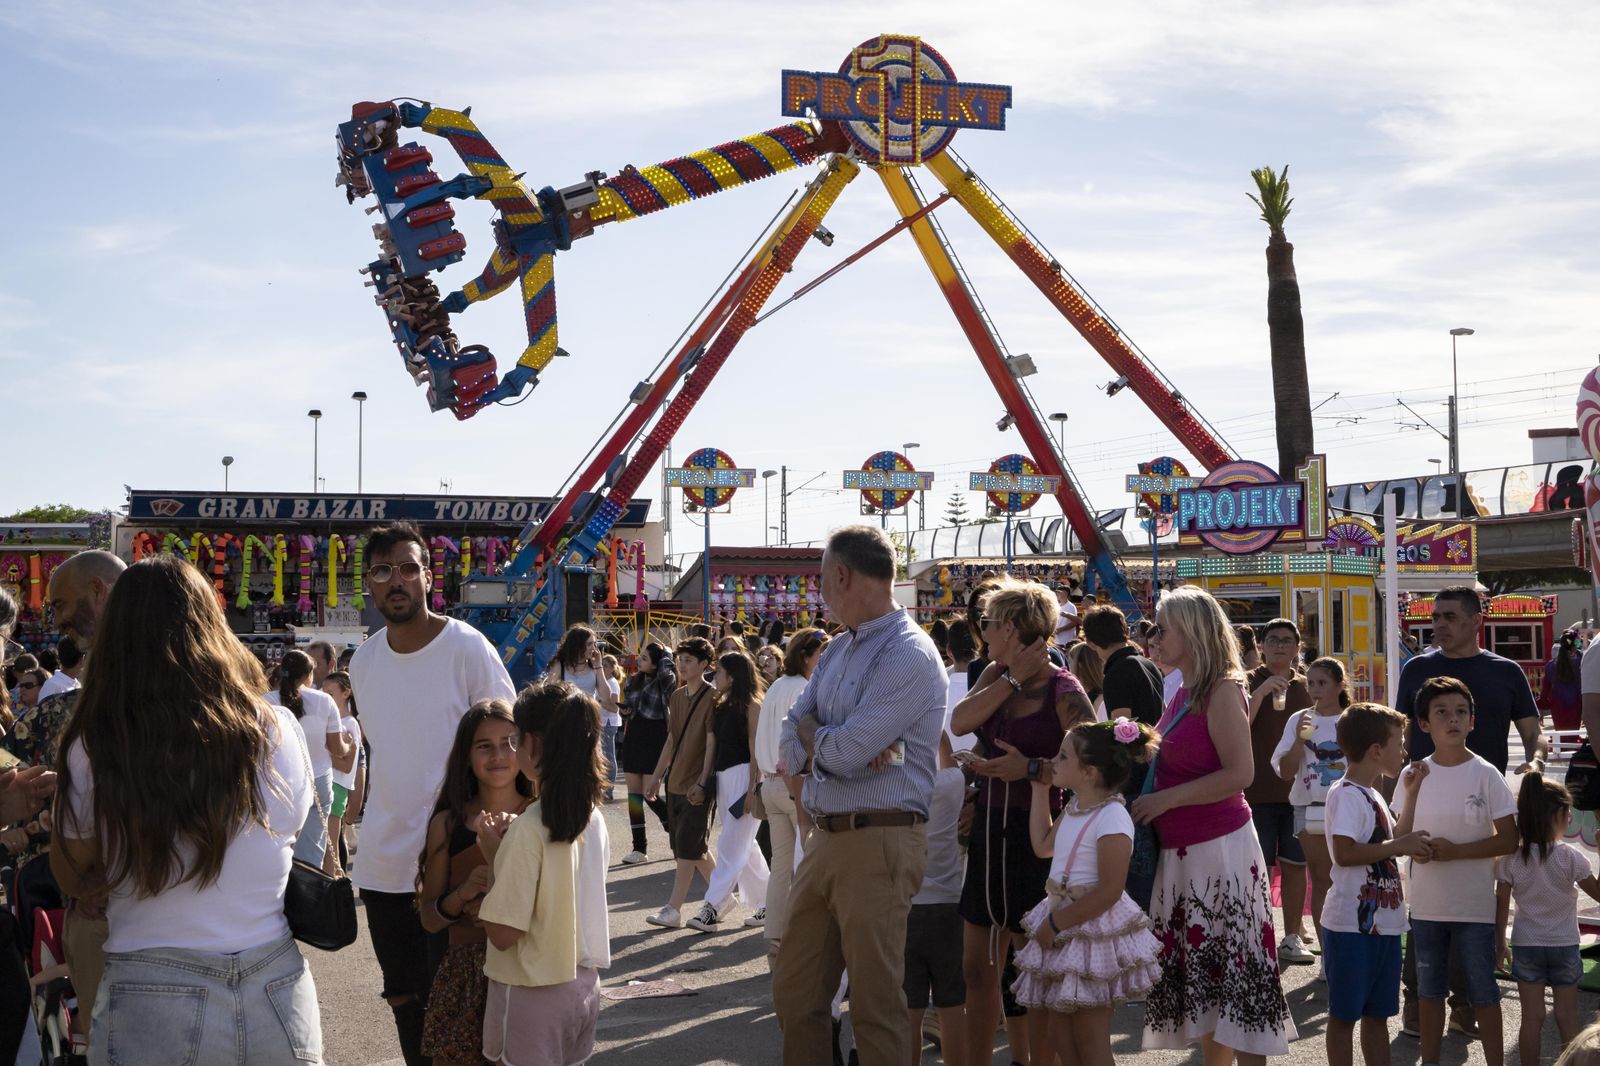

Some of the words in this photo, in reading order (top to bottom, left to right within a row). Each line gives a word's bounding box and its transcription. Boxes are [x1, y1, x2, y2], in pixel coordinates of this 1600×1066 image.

[787, 75, 1008, 125] PROJEKT
[667, 469, 755, 486] PROJEKT
[845, 472, 932, 489] PROJEKT
[971, 474, 1059, 492] PROJEKT
[1127, 476, 1194, 492] PROJEK
[1180, 487, 1300, 530] PROJEKT
[1297, 456, 1324, 538] 1
[198, 498, 282, 518] GRAN
[291, 499, 386, 520] BAZAR
[434, 501, 573, 522] TOMBOL
